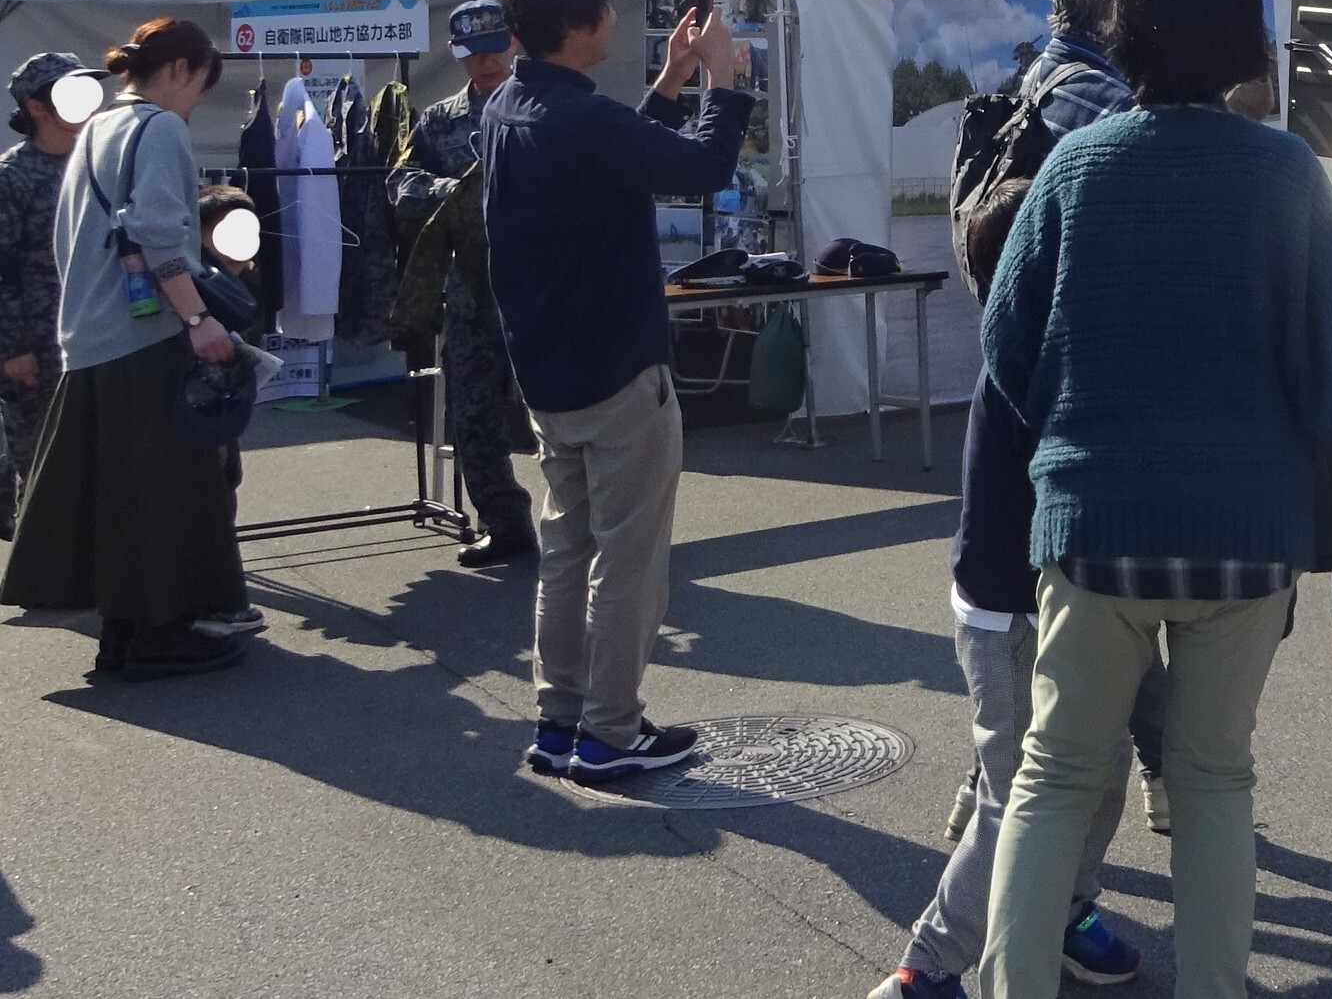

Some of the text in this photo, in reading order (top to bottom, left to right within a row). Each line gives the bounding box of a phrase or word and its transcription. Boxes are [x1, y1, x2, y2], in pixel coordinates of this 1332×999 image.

[238, 31, 253, 46] 62
[265, 23, 412, 46] 自衛隊岡山地方協力本部
